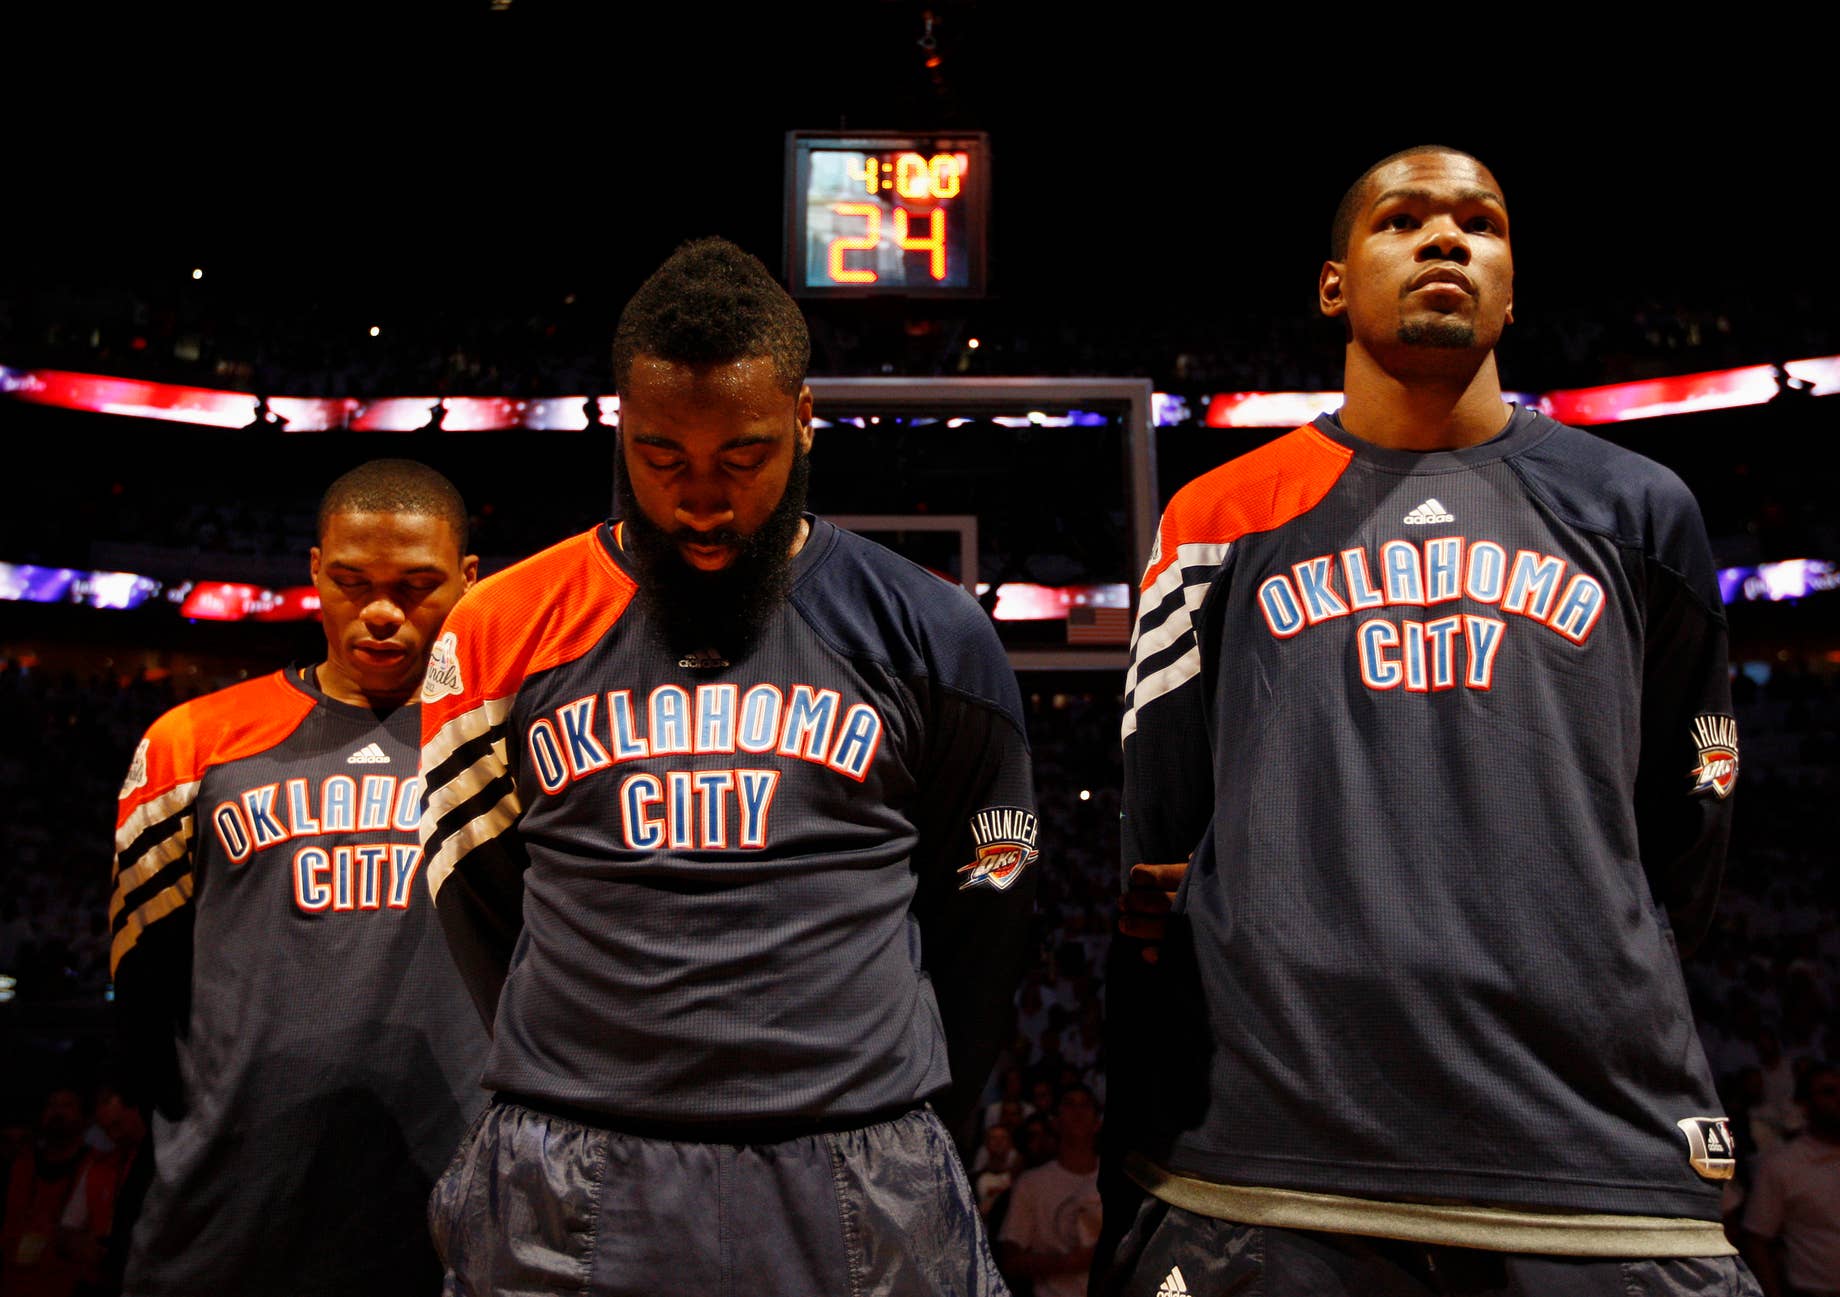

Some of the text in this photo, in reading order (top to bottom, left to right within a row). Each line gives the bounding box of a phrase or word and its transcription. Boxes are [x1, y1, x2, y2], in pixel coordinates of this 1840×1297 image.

[847, 153, 961, 199] 4:00
[828, 202, 947, 284] 24
[1403, 514, 1455, 525] adidas
[1257, 536, 1606, 647] OKLAHOMA
[1357, 613, 1507, 693] CITY
[347, 755, 391, 764] adidas
[528, 683, 883, 795] OKLAHOMA
[213, 774, 421, 865] OKLAHO
[619, 768, 781, 850] CITY
[293, 843, 425, 912] CITY
[972, 850, 1019, 878] OKC
